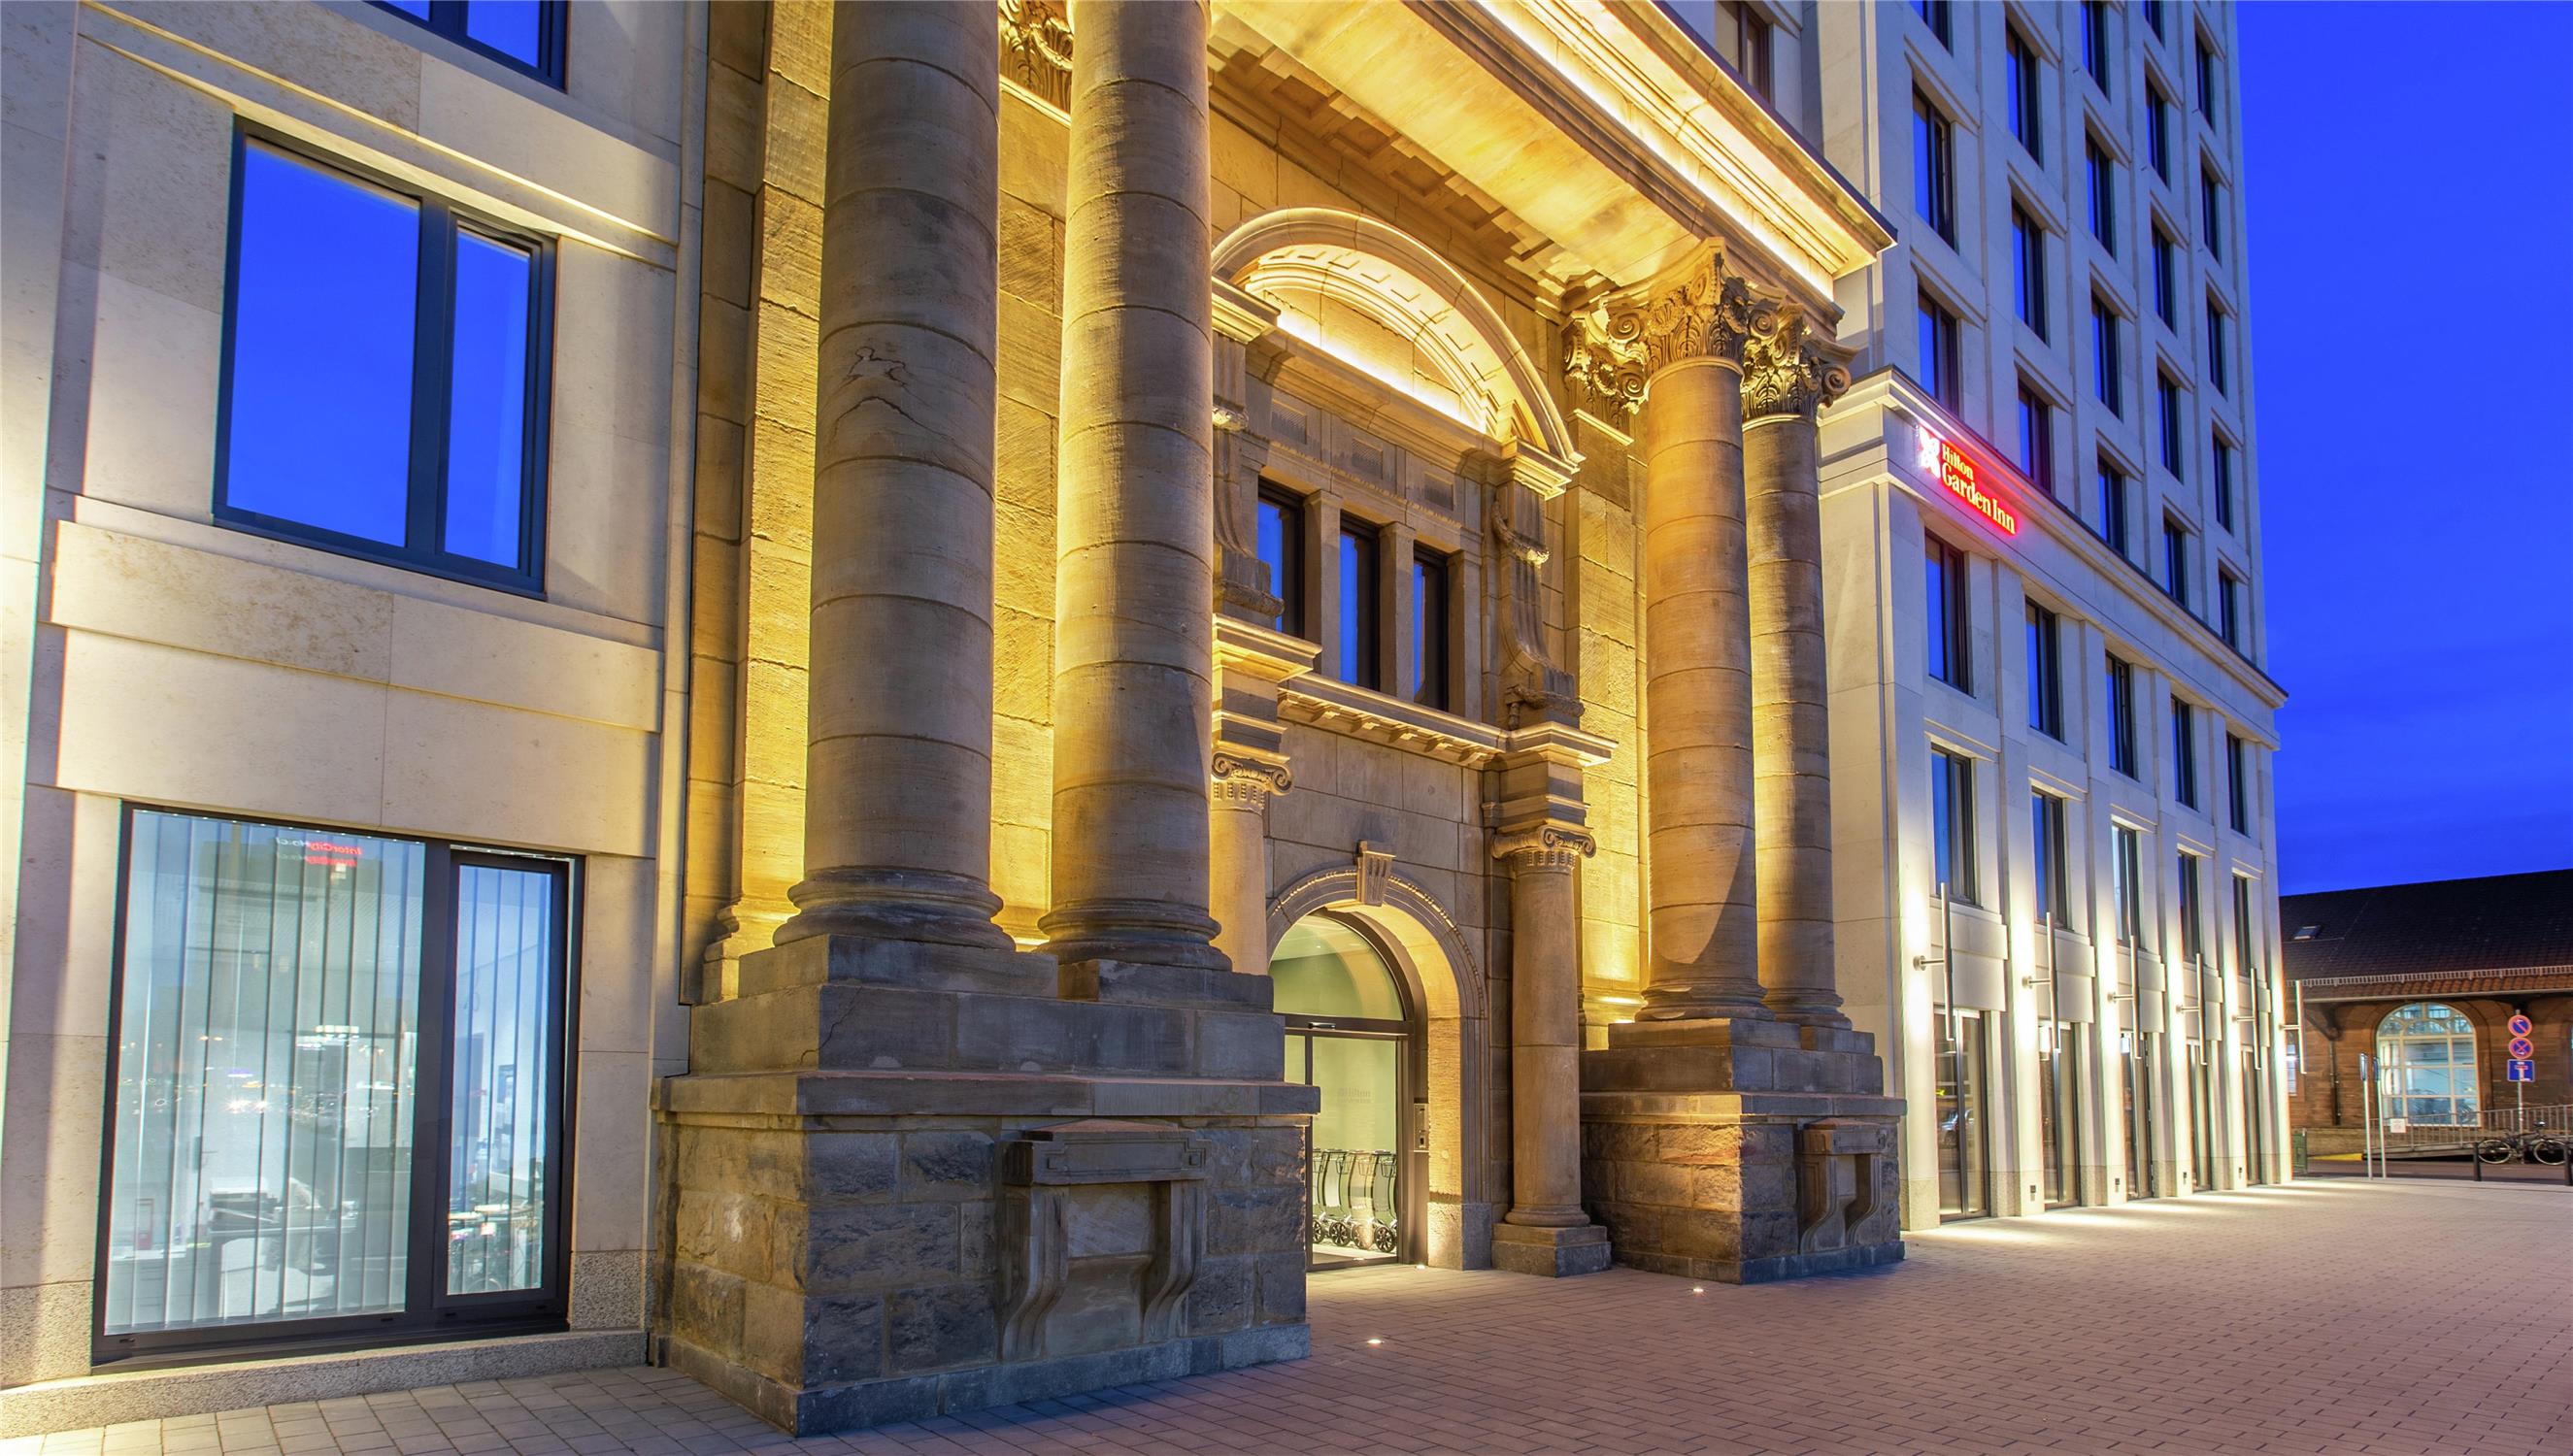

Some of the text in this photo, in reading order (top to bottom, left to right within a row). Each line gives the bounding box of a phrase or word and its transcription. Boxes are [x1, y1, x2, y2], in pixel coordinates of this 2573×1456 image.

[1942, 444, 1974, 480] Hilton
[1942, 463, 2016, 535] Garden Inn
